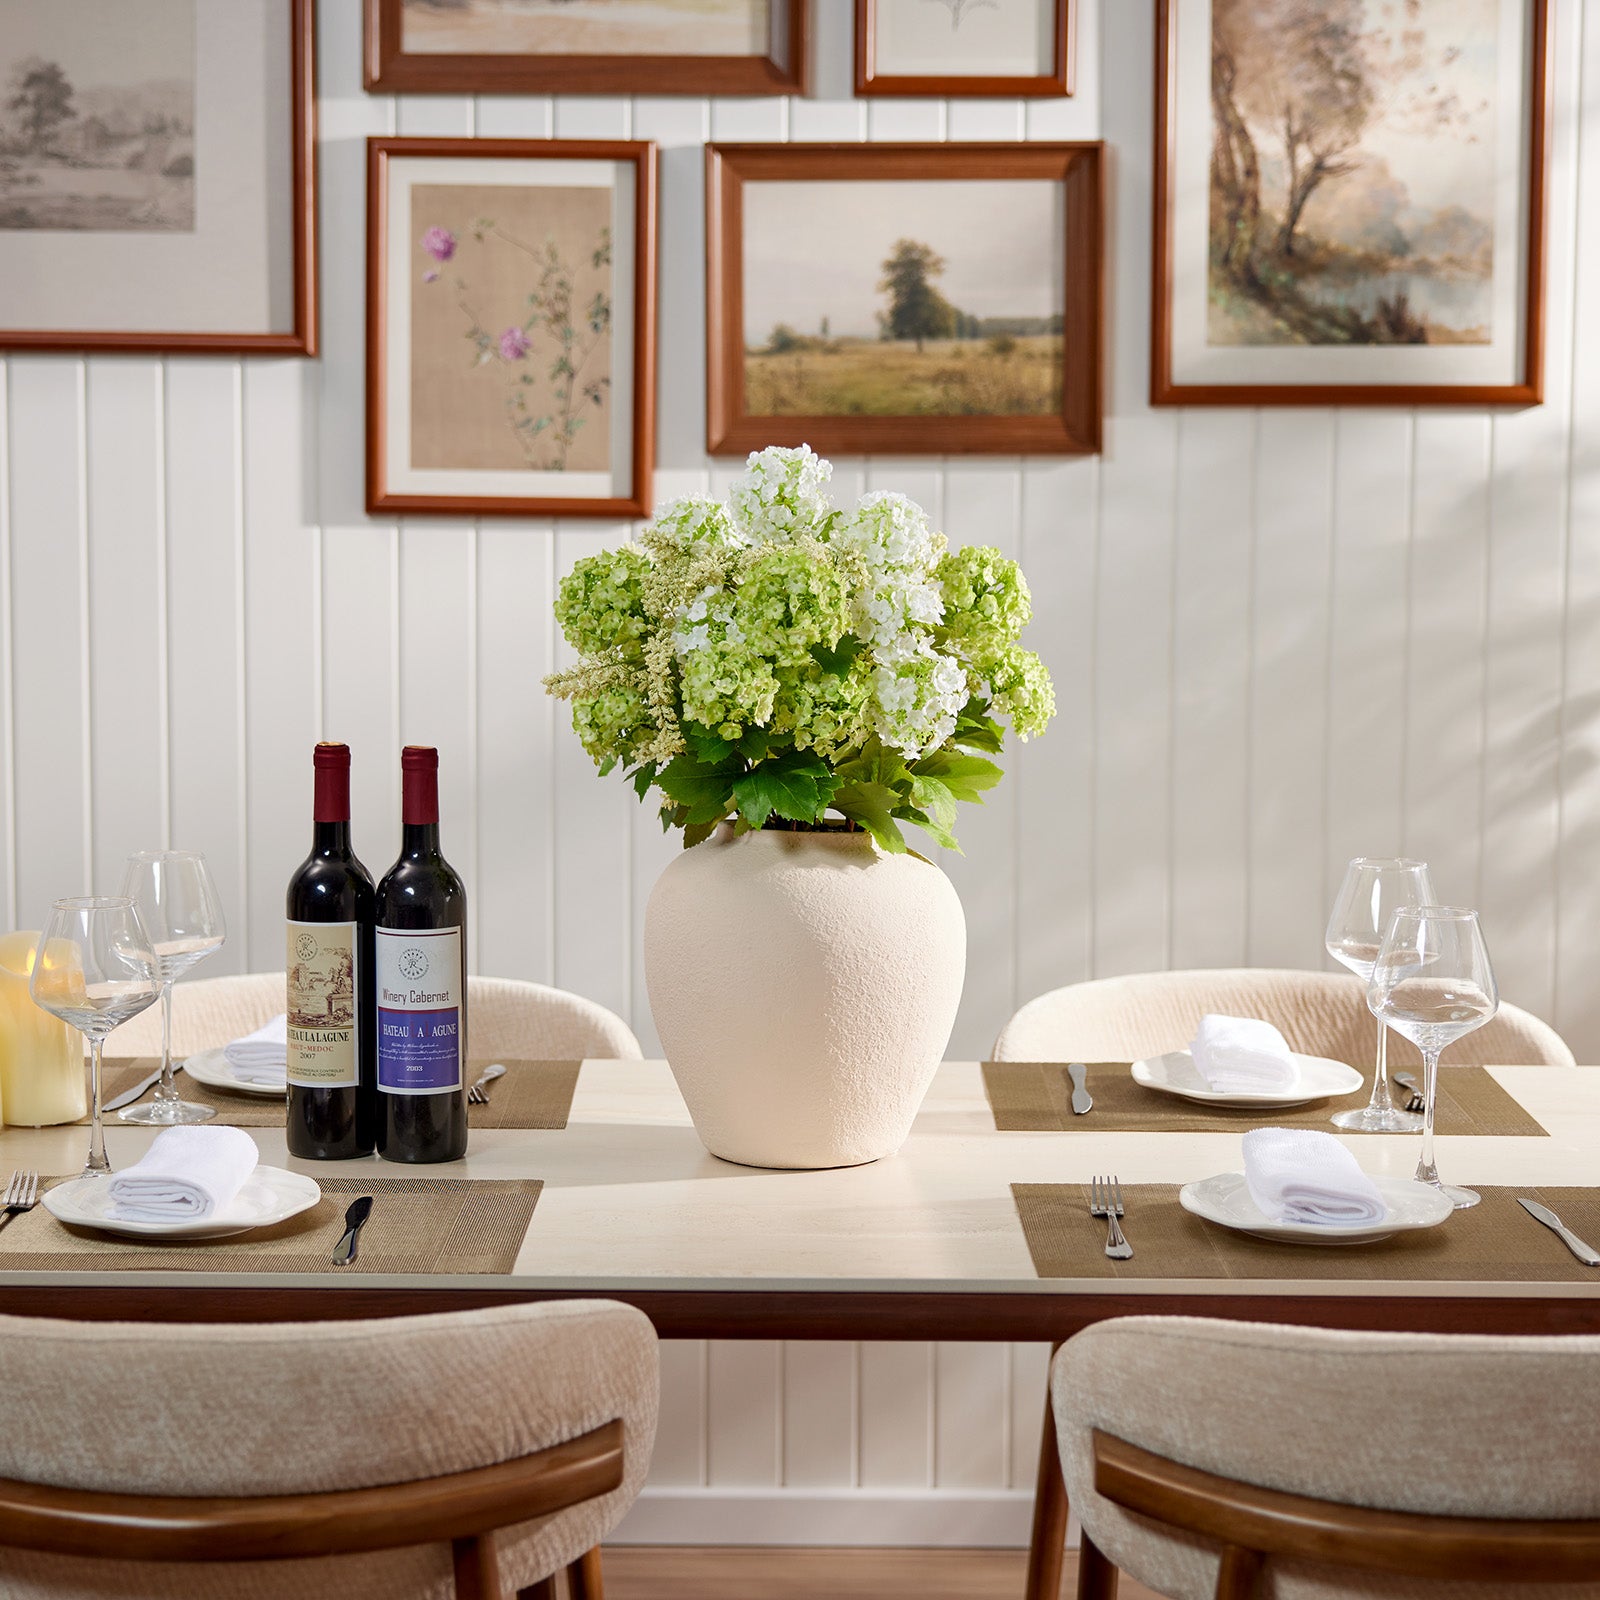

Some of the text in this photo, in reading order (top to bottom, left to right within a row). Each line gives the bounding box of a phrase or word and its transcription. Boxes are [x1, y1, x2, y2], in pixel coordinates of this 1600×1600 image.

[383, 988, 449, 1005] Winery Cabernet
[300, 1052, 316, 1060] 2007
